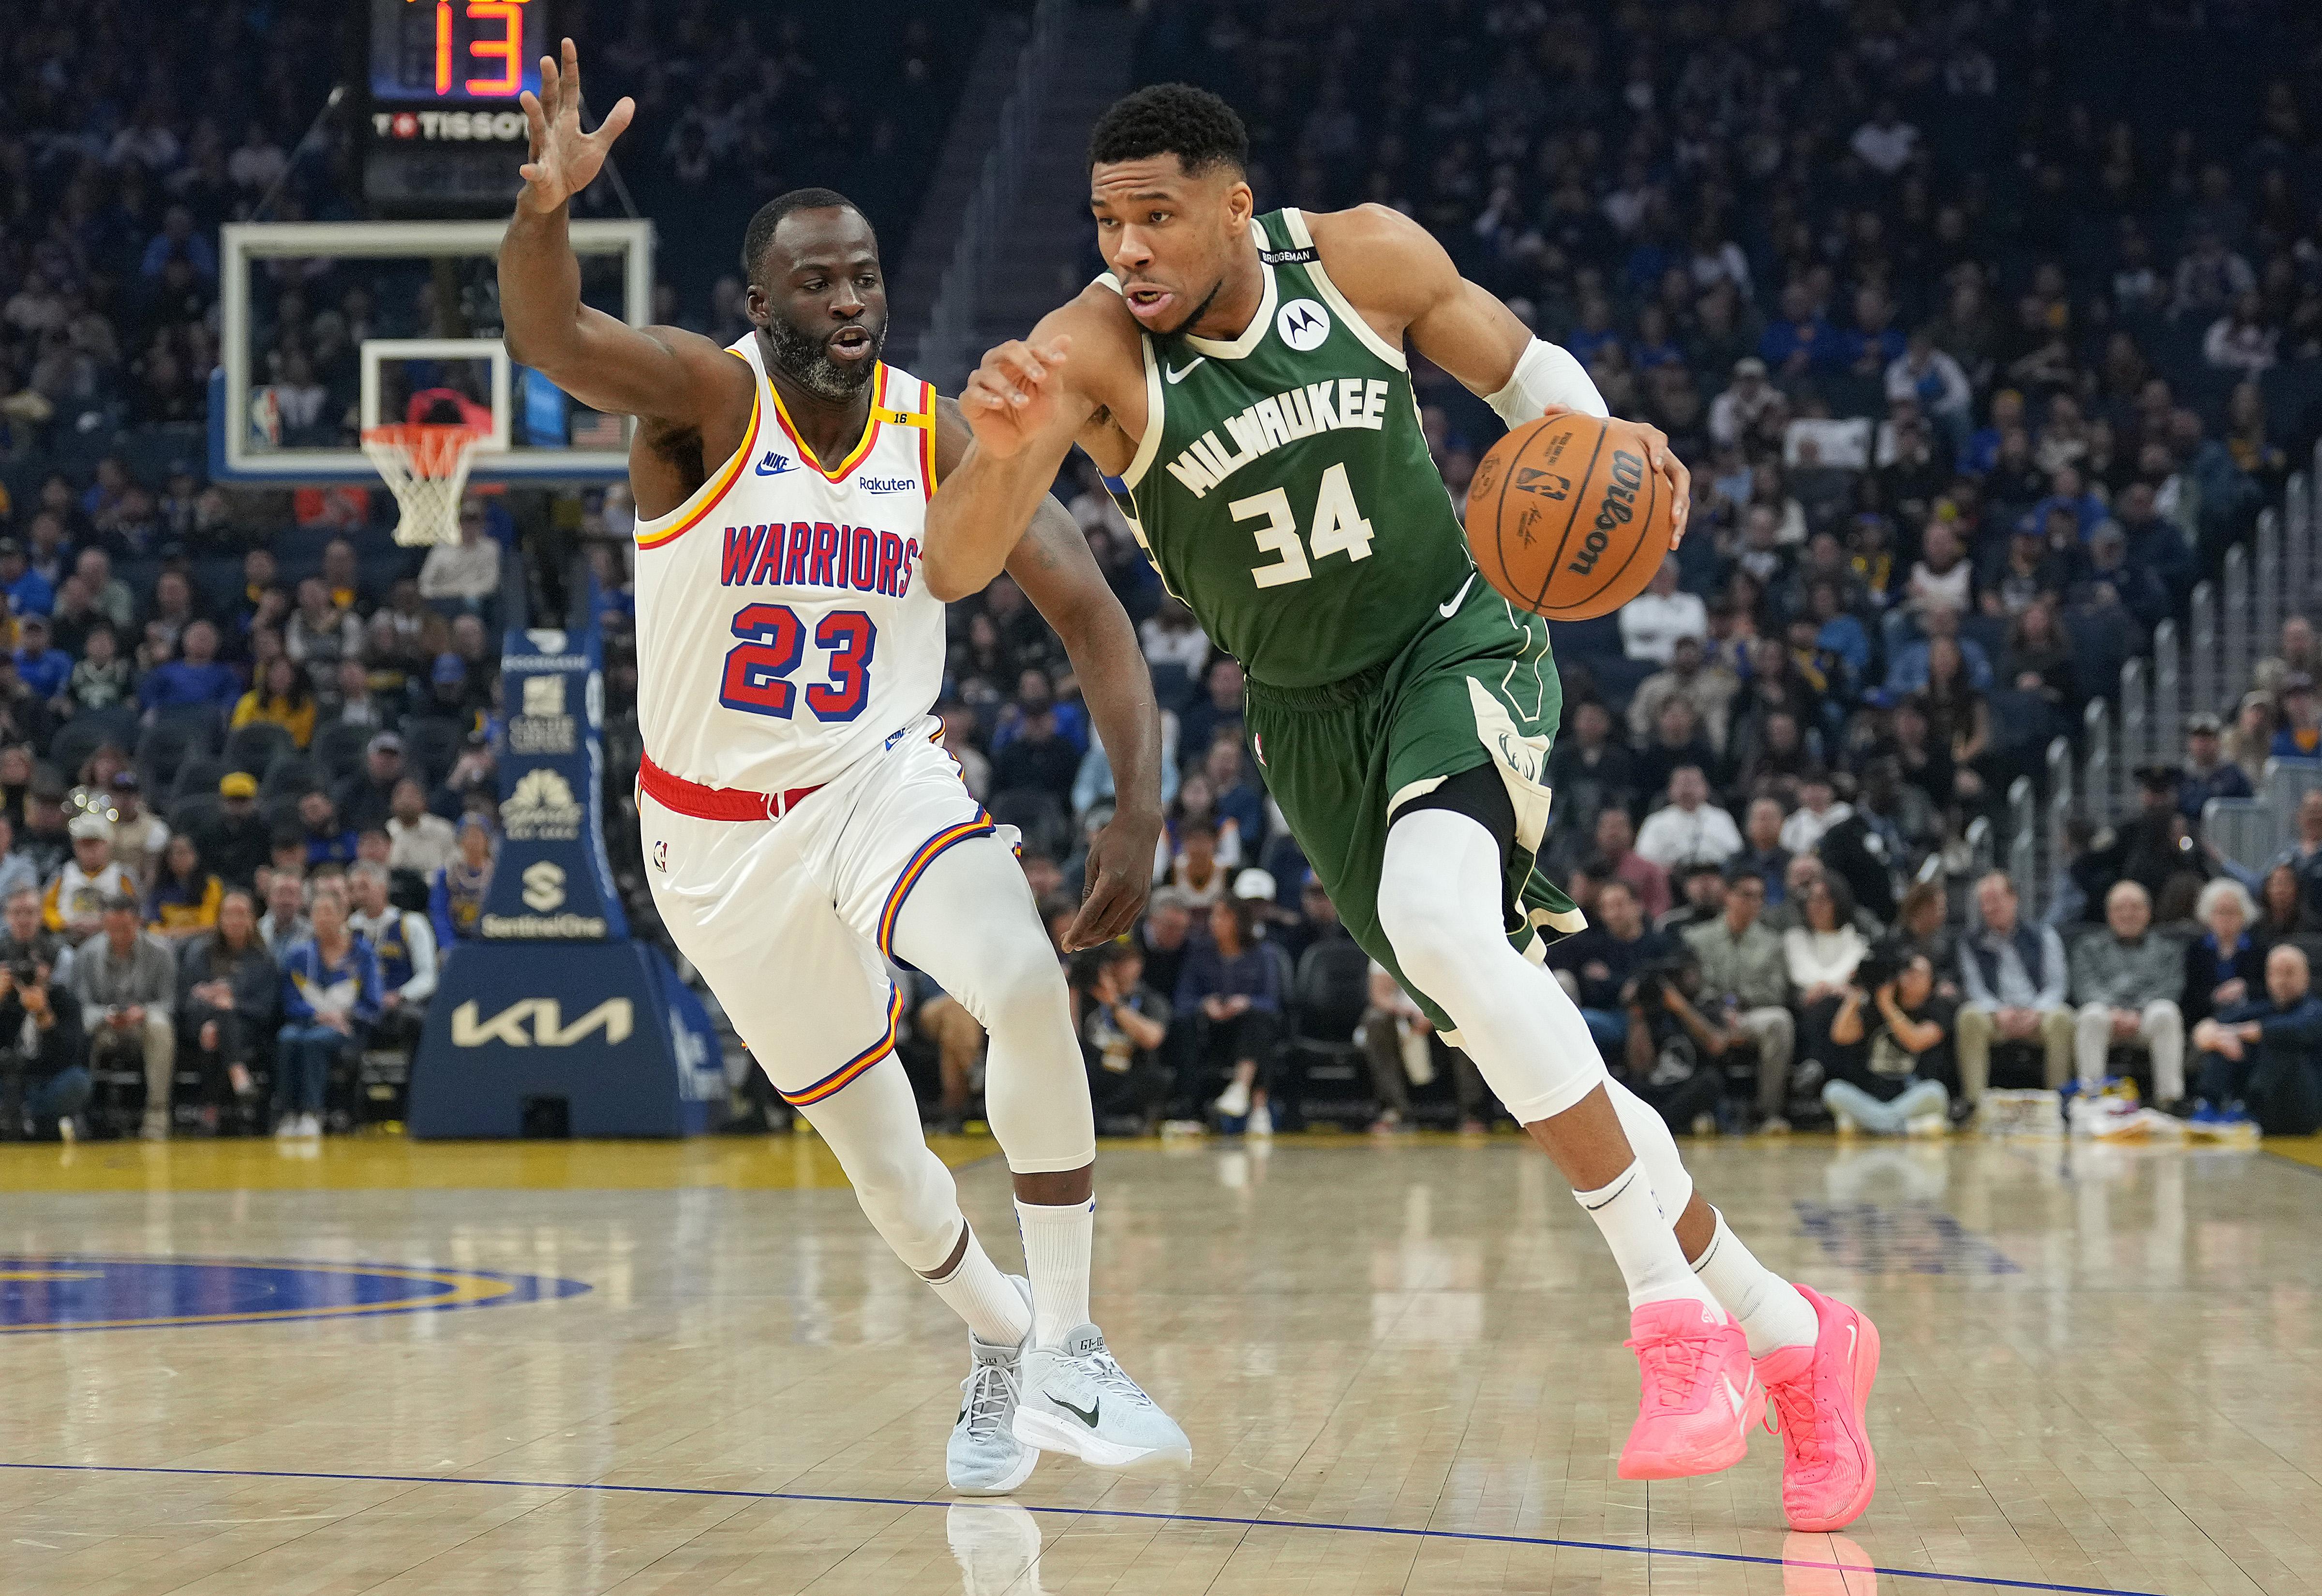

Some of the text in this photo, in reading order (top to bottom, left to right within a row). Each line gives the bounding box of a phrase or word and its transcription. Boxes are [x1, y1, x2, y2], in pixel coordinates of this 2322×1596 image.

[436, 1, 523, 96] 13
[1262, 251, 1310, 263] BRIDGEMAN
[762, 451, 789, 471] NIKE
[894, 414, 908, 424] 16
[1165, 378, 1388, 499] MILWAUKEE
[860, 476, 915, 490] Rakuten
[1228, 462, 1375, 589] 34
[1568, 450, 1643, 576] Wilson
[721, 522, 918, 598] WARRIORS
[719, 603, 878, 722] 23
